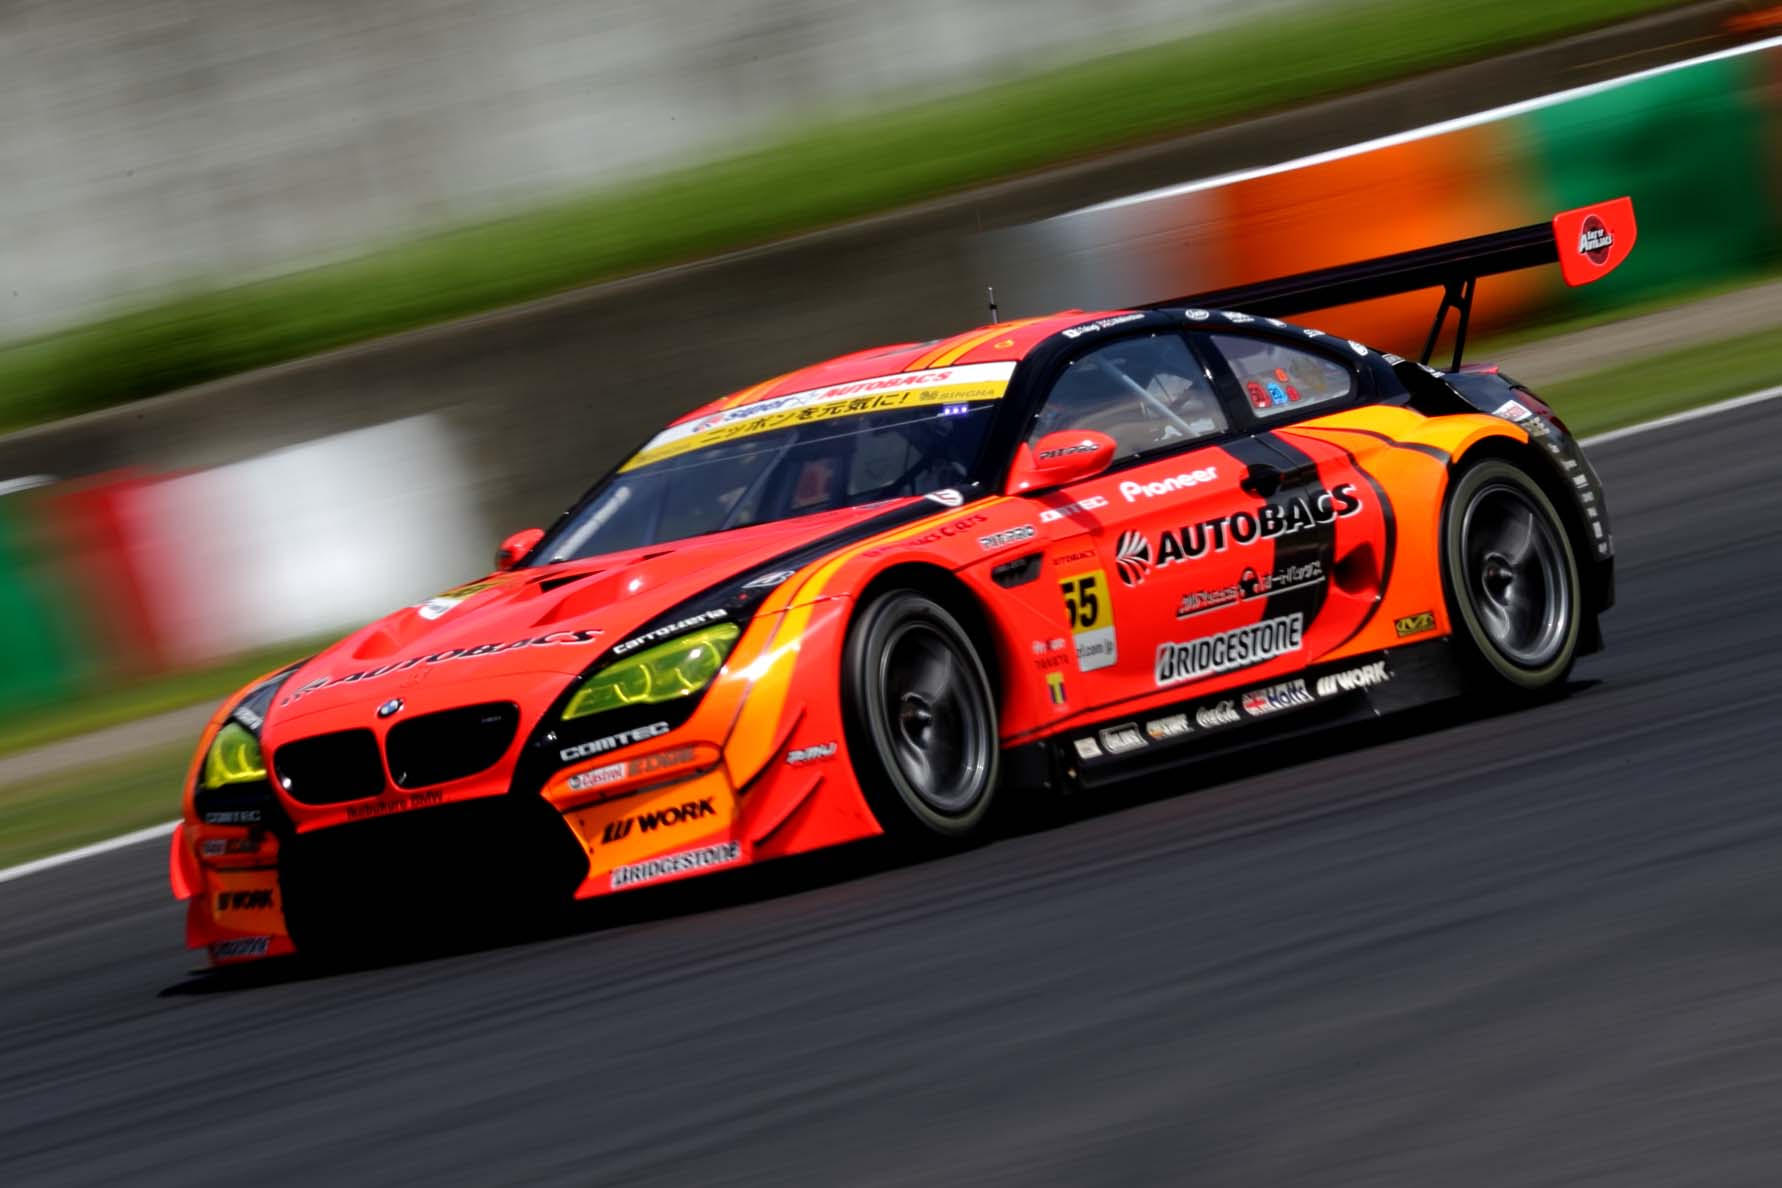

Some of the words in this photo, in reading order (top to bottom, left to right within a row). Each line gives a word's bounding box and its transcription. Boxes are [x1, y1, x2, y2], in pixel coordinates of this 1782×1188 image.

[815, 371, 952, 399] AUTOBACS
[1119, 466, 1218, 502] Pioneer
[1155, 483, 1363, 569] AUTOBACS
[326, 630, 604, 688] AUTOBACS
[1157, 614, 1302, 683] BRIDGESTONE
[1336, 660, 1390, 691] WORK
[559, 721, 670, 761] COMTEC
[639, 797, 717, 831] WORK
[613, 841, 741, 888] BRIDGESTONE
